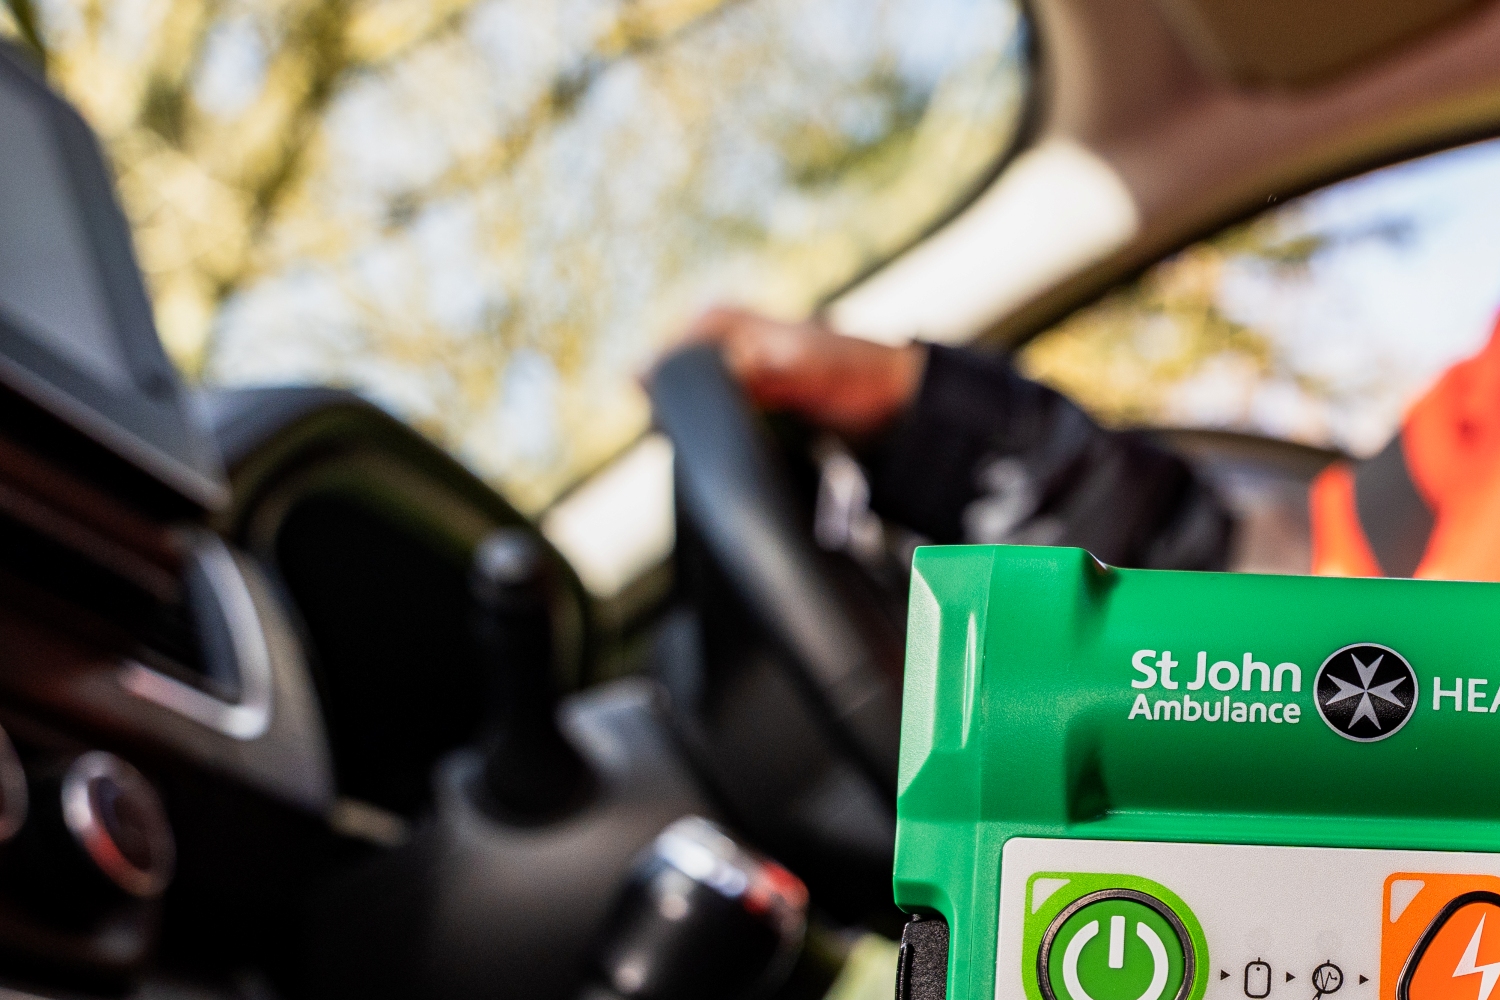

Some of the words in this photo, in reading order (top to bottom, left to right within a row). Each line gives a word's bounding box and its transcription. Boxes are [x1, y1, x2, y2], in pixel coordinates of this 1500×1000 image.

[1130, 649, 1179, 690] St
[1186, 651, 1302, 692] John
[1127, 693, 1302, 724] Ambulance
